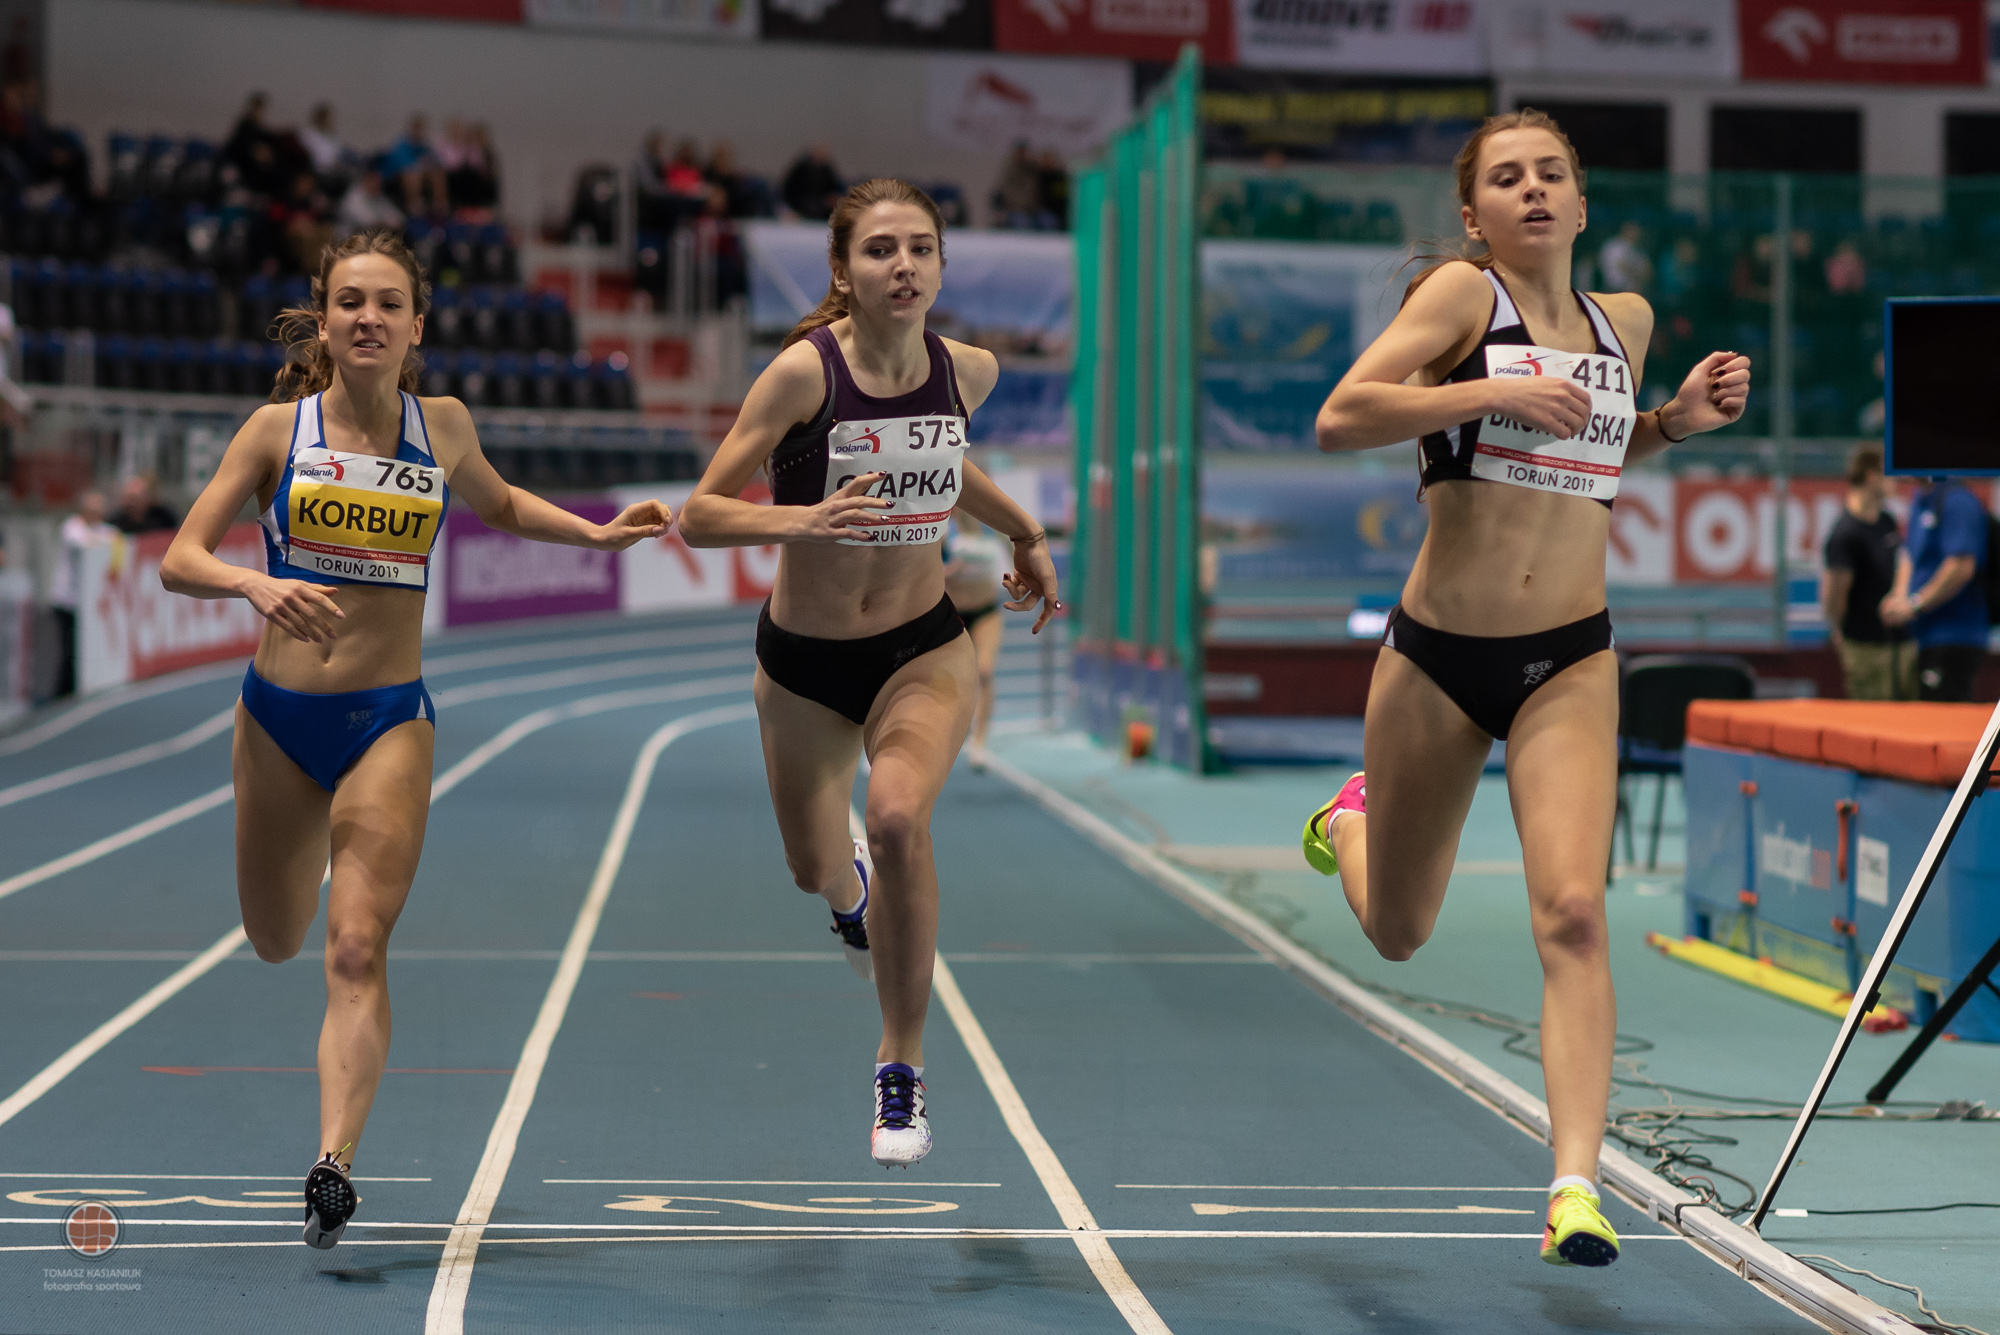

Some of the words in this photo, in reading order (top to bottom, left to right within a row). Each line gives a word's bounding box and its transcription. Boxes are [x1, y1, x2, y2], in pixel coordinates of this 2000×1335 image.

[1494, 366, 1532, 376] polanik
[1571, 358, 1627, 395] 411
[908, 419, 962, 450] 575
[834, 442, 871, 455] polanik
[299, 467, 334, 478] polanik
[375, 460, 434, 494] 765
[1507, 464, 1559, 487] TORUŃ
[1562, 475, 1595, 493] 2019
[298, 497, 429, 539] KORBUT
[905, 526, 938, 542] 2019
[314, 556, 364, 576] TORUŃ
[367, 564, 400, 579] 2019
